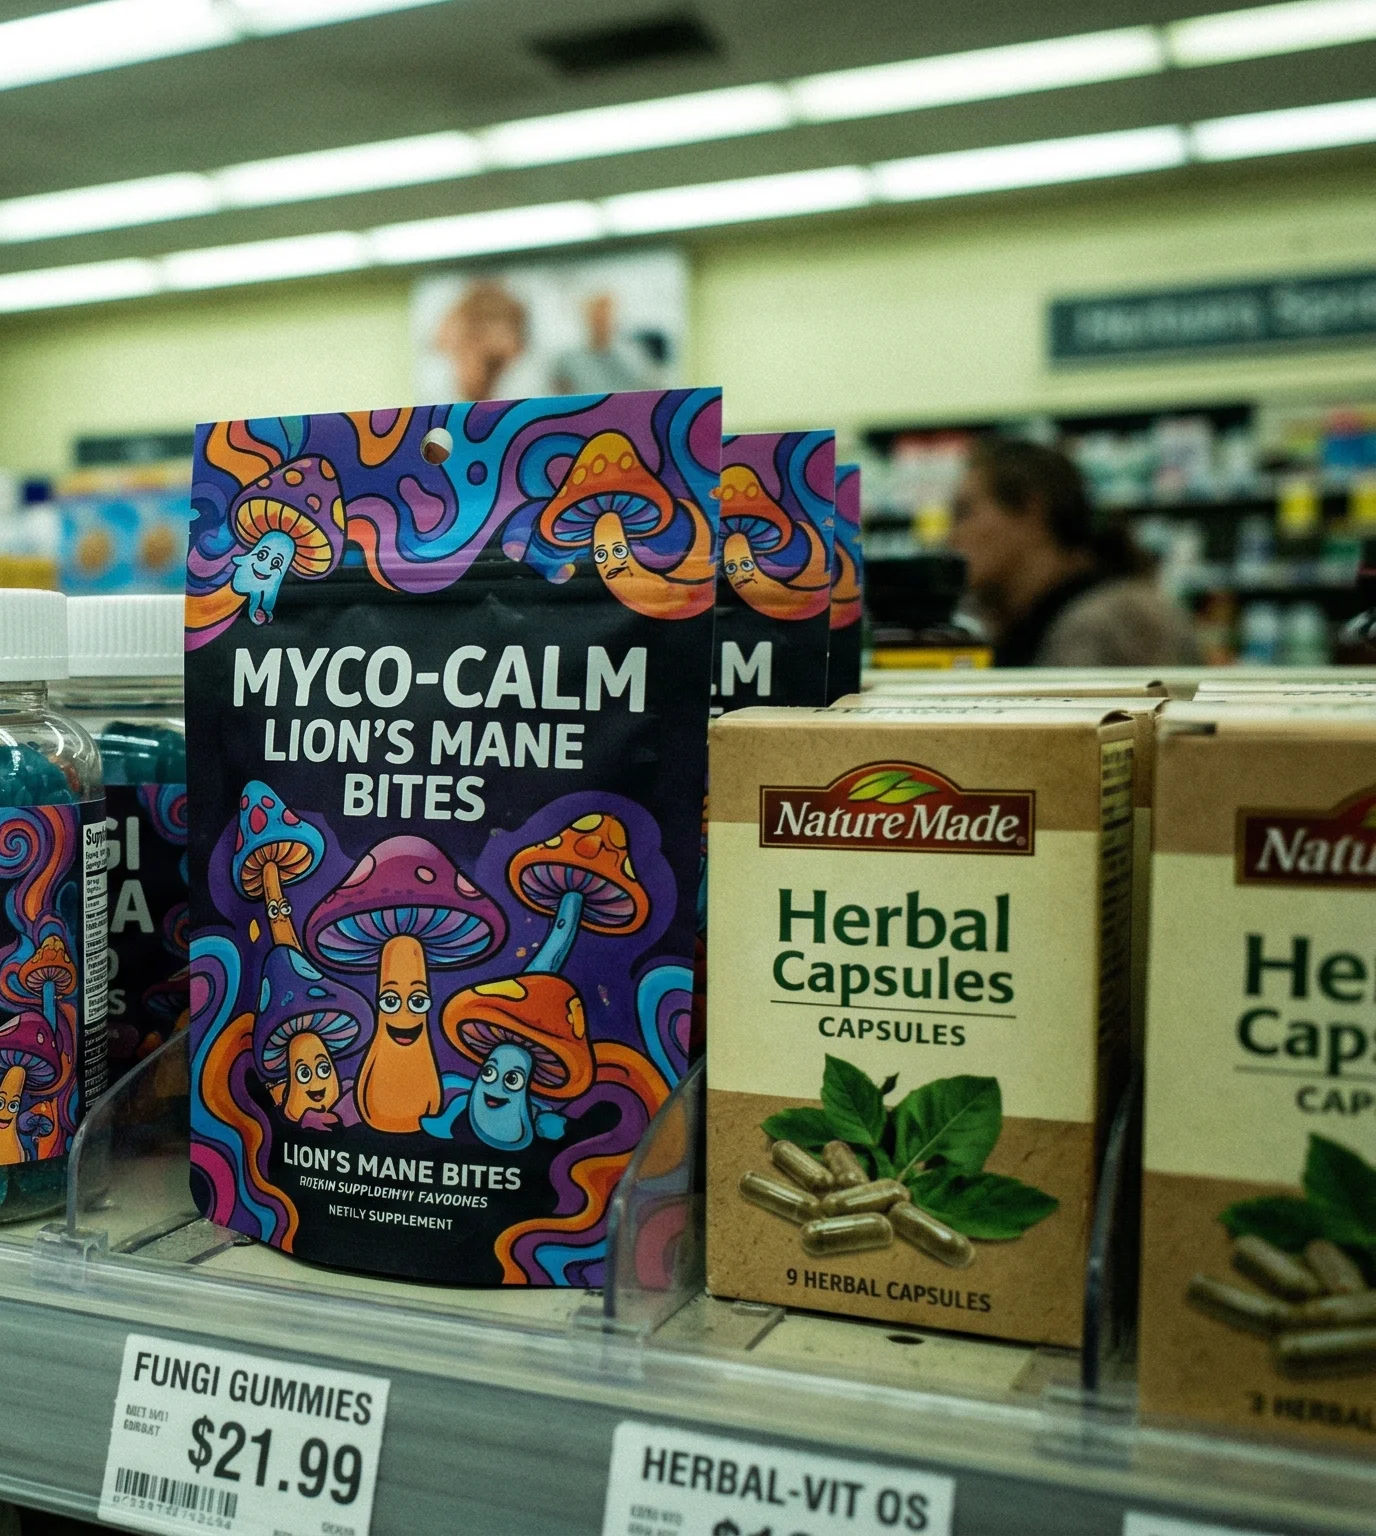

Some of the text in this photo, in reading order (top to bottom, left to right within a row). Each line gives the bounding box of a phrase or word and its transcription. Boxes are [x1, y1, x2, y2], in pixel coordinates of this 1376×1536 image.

[233, 645, 647, 712] MYCO-CALM
[264, 719, 585, 769] LION'S MANE
[343, 773, 485, 821] BITES
[778, 888, 1010, 953] Herbal
[772, 950, 1015, 1007] Capsules
[818, 1016, 966, 1046] CAPSULES
[283, 1142, 522, 1190] LION'S MANE BITES
[368, 1210, 453, 1230] SUPPLEMENT
[786, 1268, 992, 1313] 9 HERBAL CAPSULES
[133, 1352, 373, 1426] FUNGI GUMMIES
[187, 1415, 363, 1505] $21.99
[641, 1446, 929, 1531] HERBAL-VIT OS
